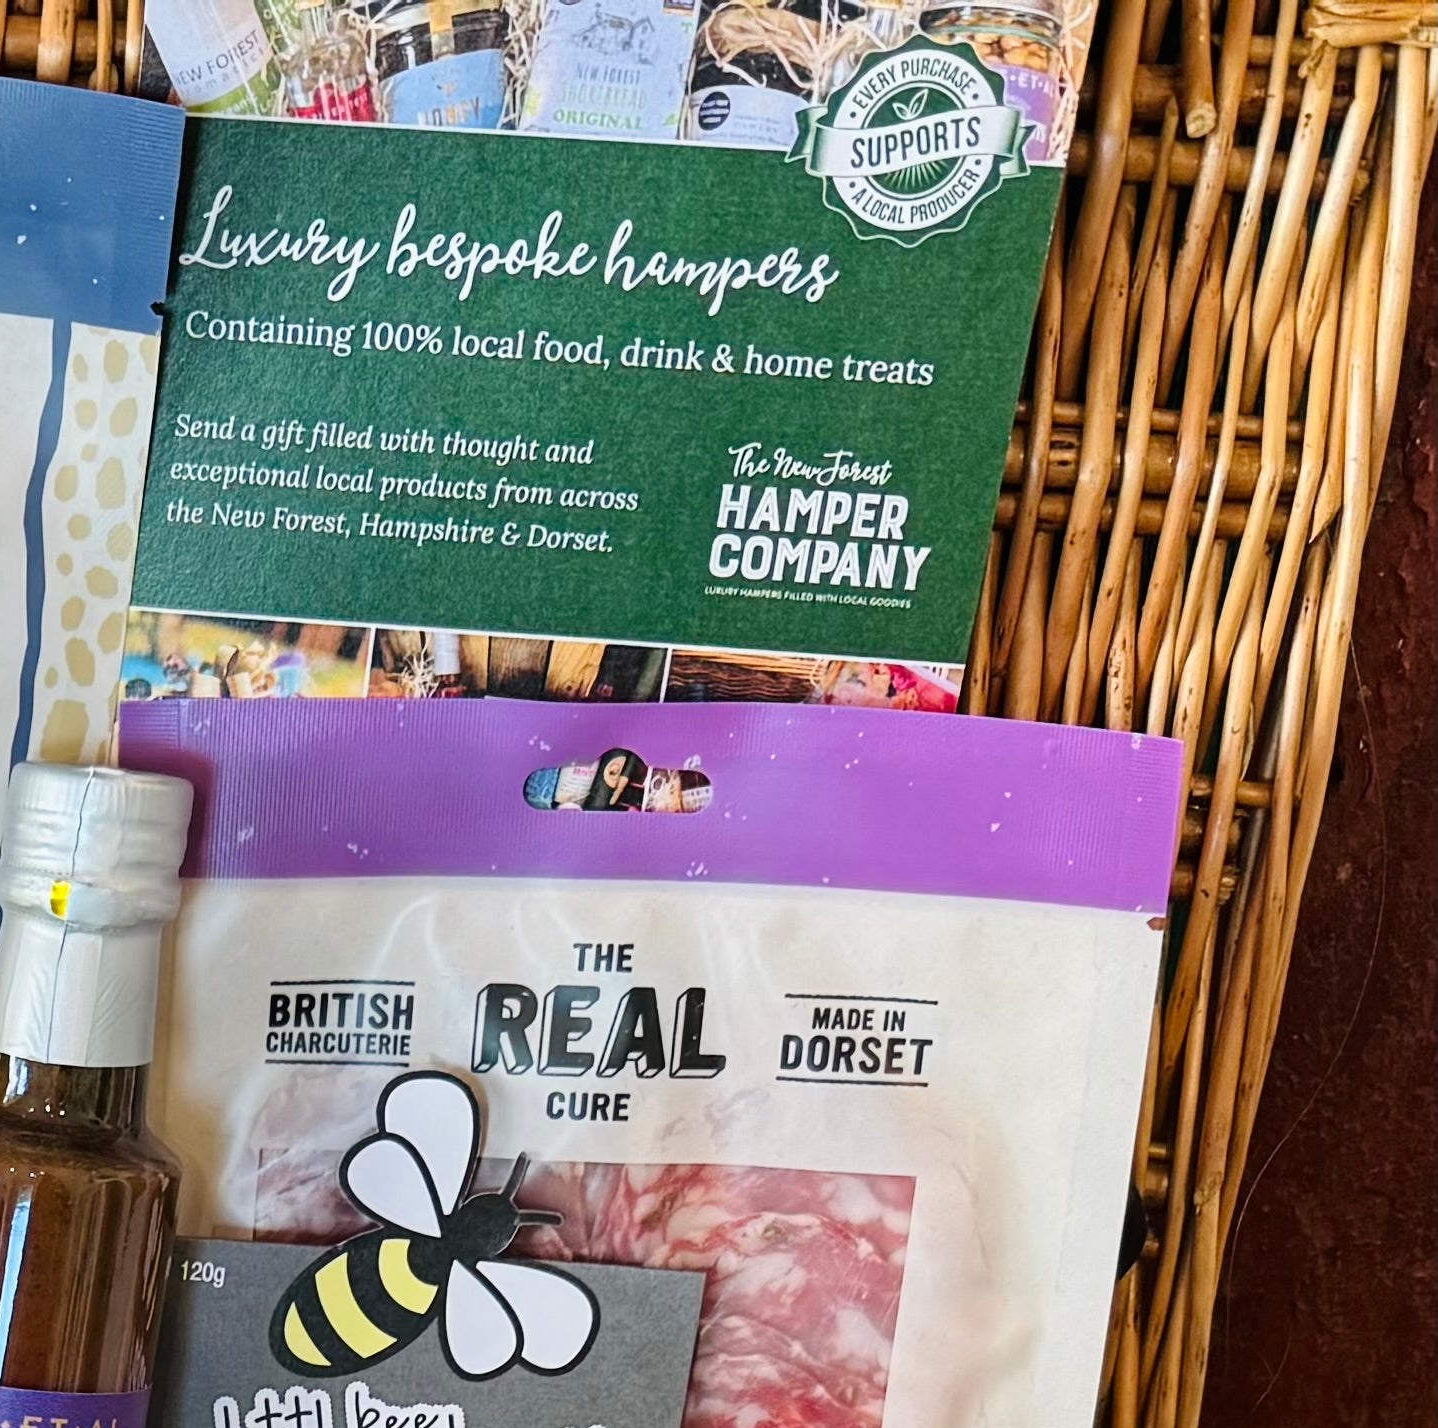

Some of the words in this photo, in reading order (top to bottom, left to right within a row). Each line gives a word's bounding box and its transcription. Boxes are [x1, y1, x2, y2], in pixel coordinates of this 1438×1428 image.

[853, 65, 896, 109] EVERY
[901, 58, 976, 95] PURCHASE
[850, 117, 981, 168] SUPPORTS
[851, 188, 866, 205] A
[862, 196, 904, 223] LOCAL
[910, 169, 980, 223] PRODUCER
[179, 184, 381, 301] Luxury
[387, 202, 596, 300] bespoke
[604, 218, 839, 317] hampers
[185, 308, 356, 355] Containing
[361, 320, 443, 356] 100%
[452, 325, 524, 361] local
[532, 328, 610, 368] food,
[620, 338, 701, 372] drink
[710, 341, 734, 372] &
[745, 346, 833, 378] home
[842, 351, 934, 386] treats
[170, 458, 308, 498] exceptional
[314, 463, 377, 494] local
[383, 468, 486, 505] products
[491, 472, 551, 512] from
[559, 484, 639, 510] across
[716, 484, 909, 540] HAMPER
[709, 534, 931, 591] COMPANY
[267, 993, 415, 1032] BRITISH
[266, 1029, 411, 1056] CHARCUTERIE
[778, 1036, 933, 1077] DORSET
[180, 1261, 226, 1288] 120g
